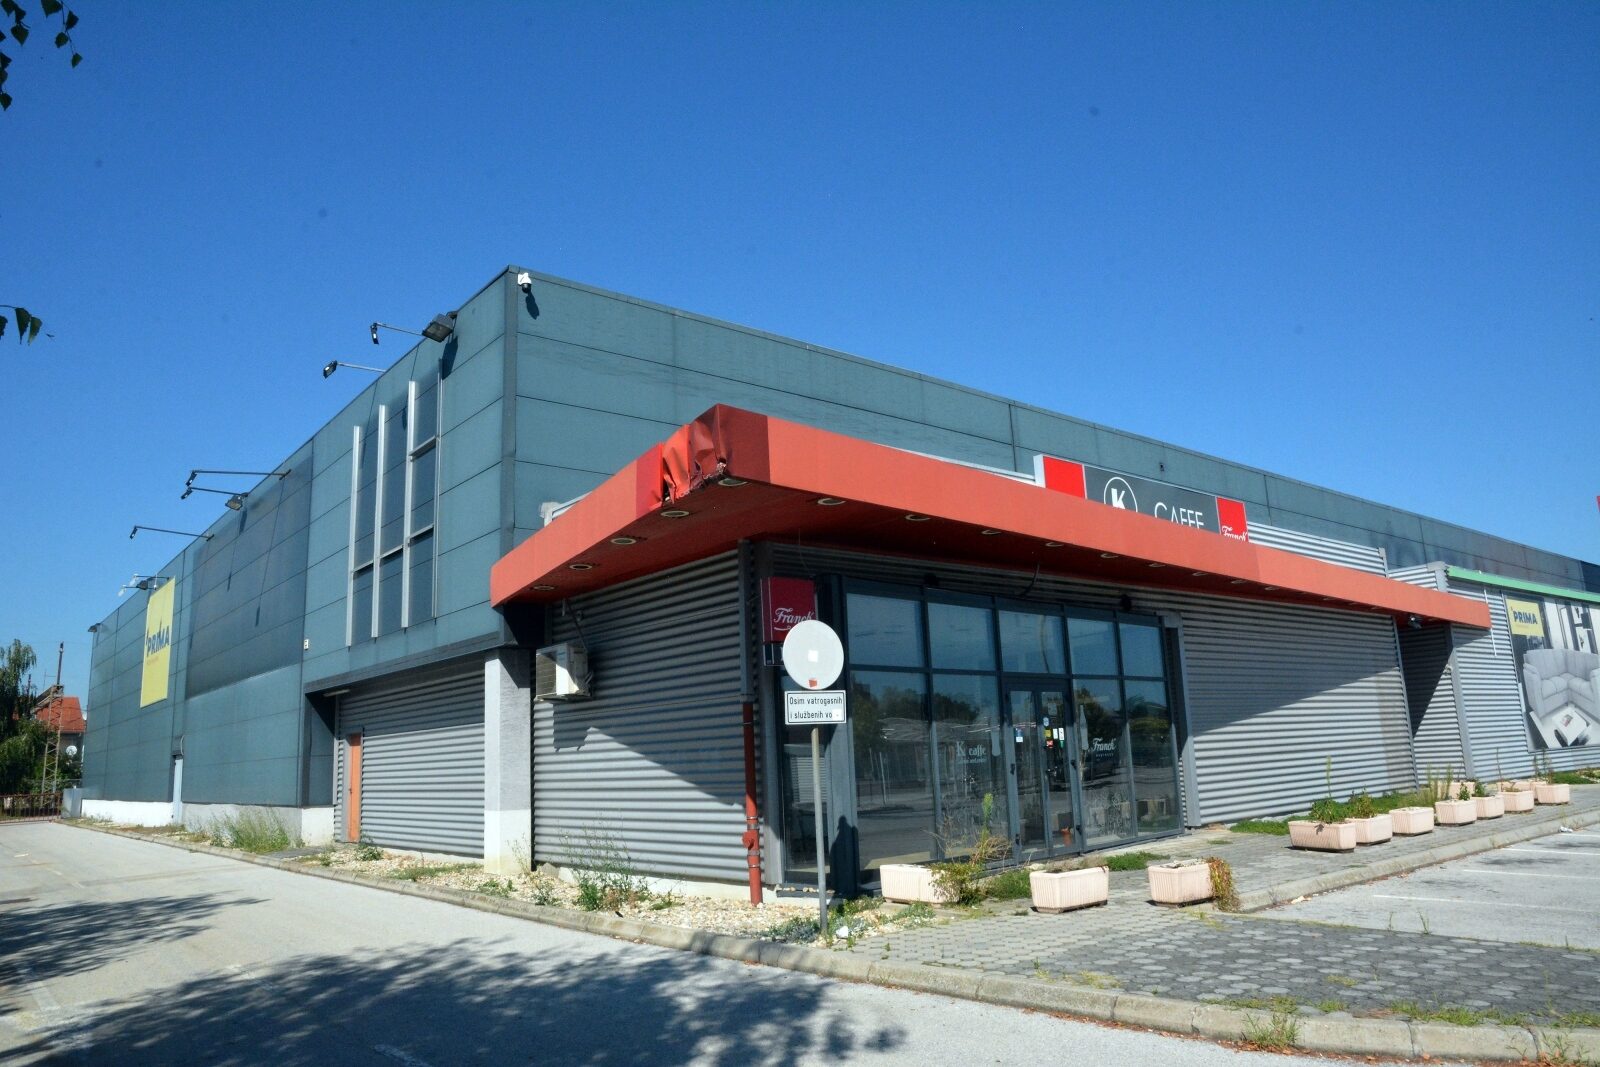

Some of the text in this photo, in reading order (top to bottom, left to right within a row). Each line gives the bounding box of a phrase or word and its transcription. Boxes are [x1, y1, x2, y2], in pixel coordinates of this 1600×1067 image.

[1111, 487, 1126, 510] K
[773, 607, 814, 624] Franck
[1512, 610, 1538, 625] PRIMA
[146, 624, 170, 657] PRIMA
[789, 696, 843, 707] Osim vatrogasnih
[794, 711, 824, 719] službenih
[1091, 737, 1117, 752] Franck
